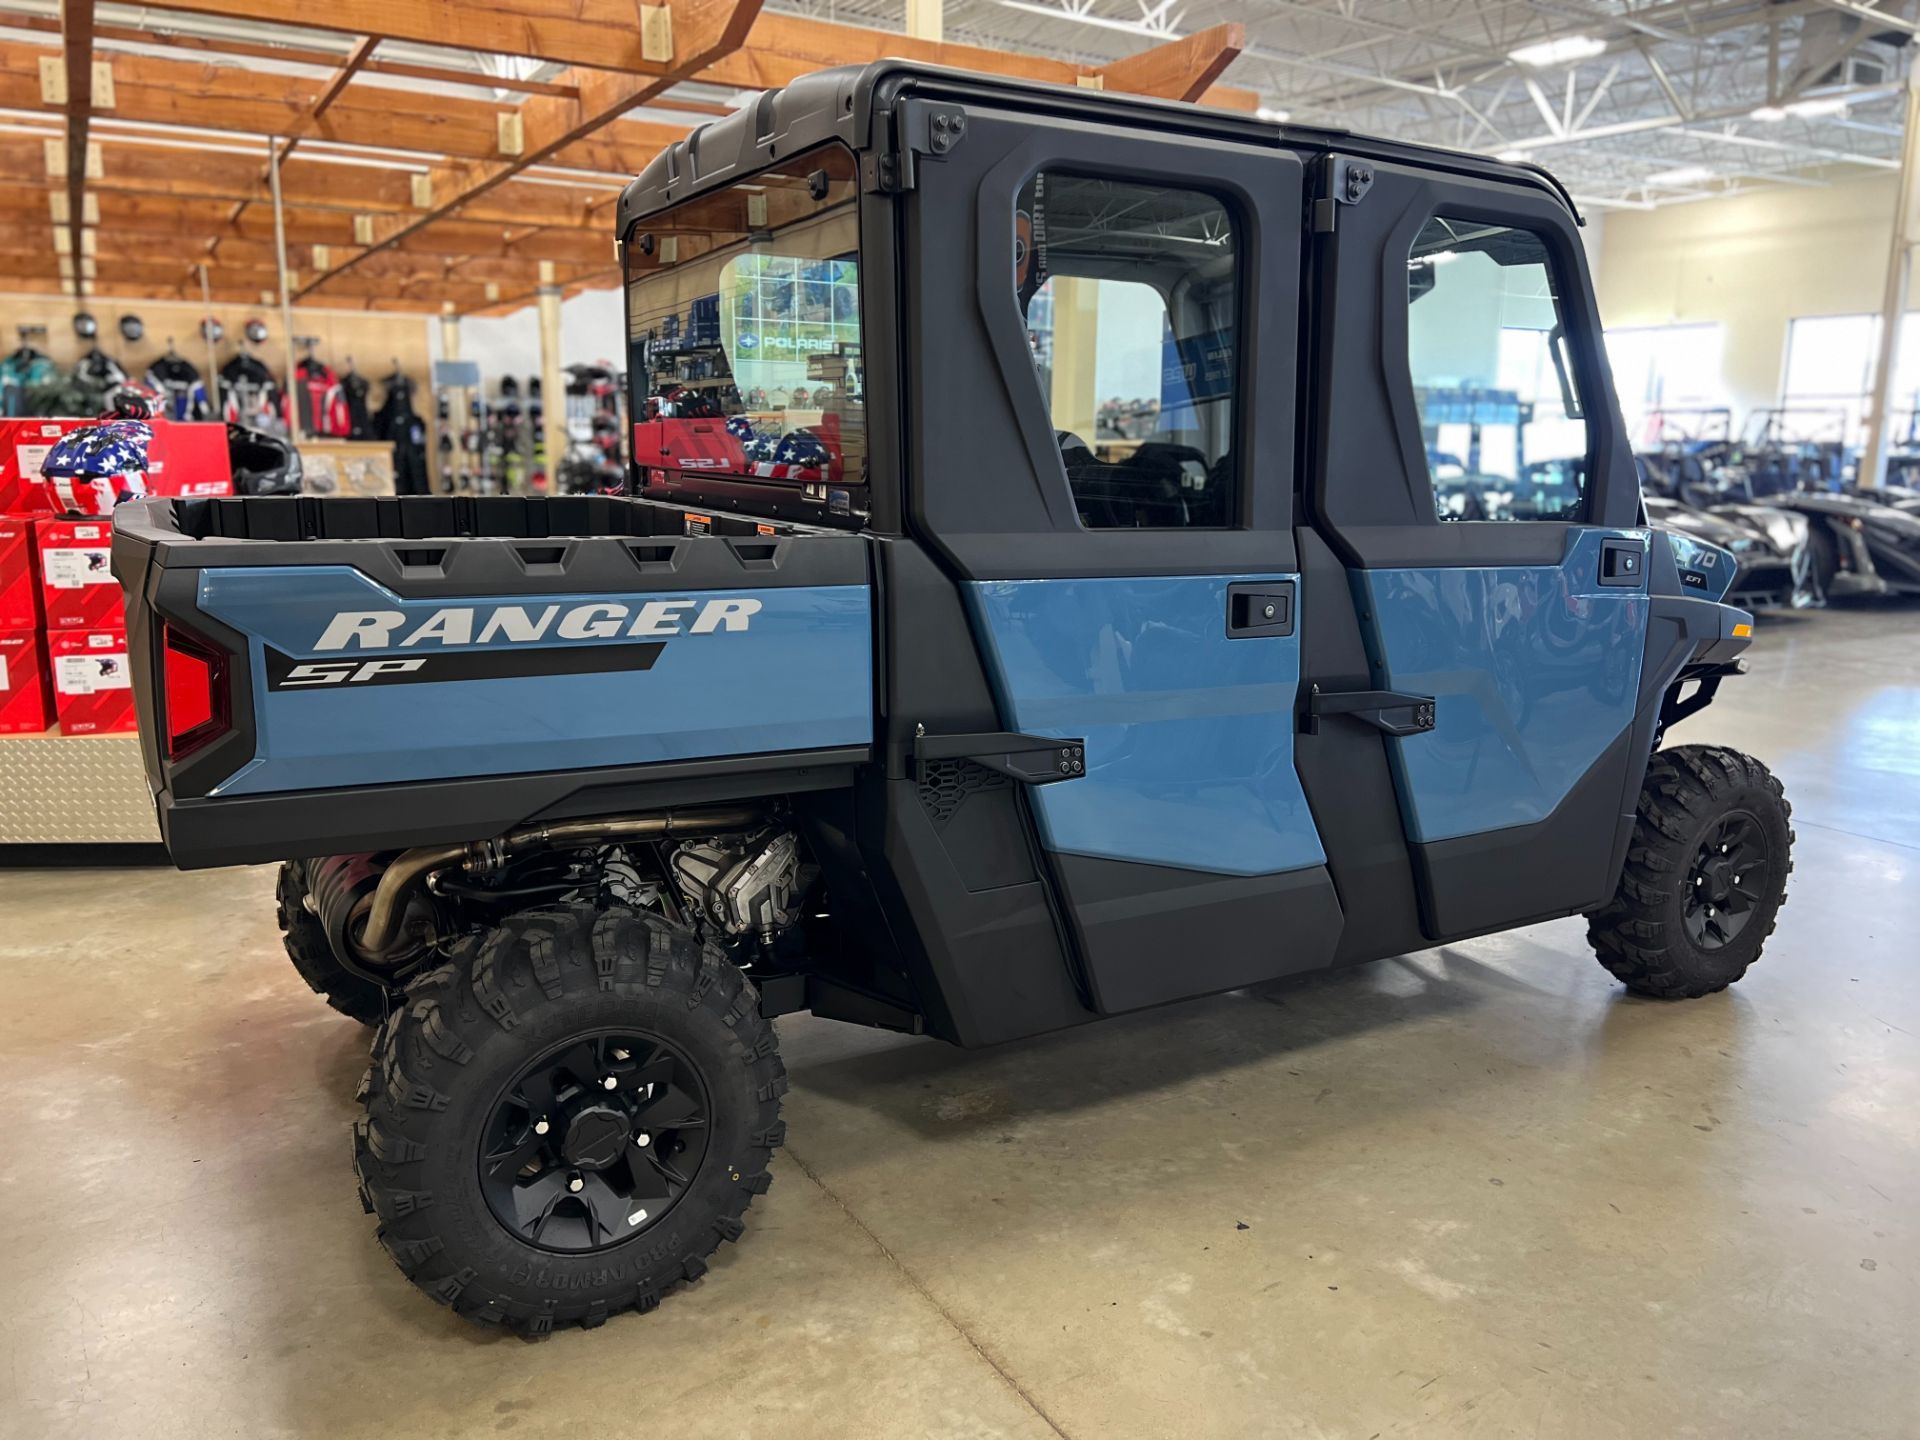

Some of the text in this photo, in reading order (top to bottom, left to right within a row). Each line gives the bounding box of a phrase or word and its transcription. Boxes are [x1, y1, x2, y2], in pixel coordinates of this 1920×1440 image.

[1033, 203, 1046, 241] DIRT
[1037, 244, 1047, 269] AND
[764, 336, 833, 350] POLARIS
[180, 482, 229, 496] LS2
[312, 598, 763, 651] RANGER
[279, 659, 427, 686] SP
